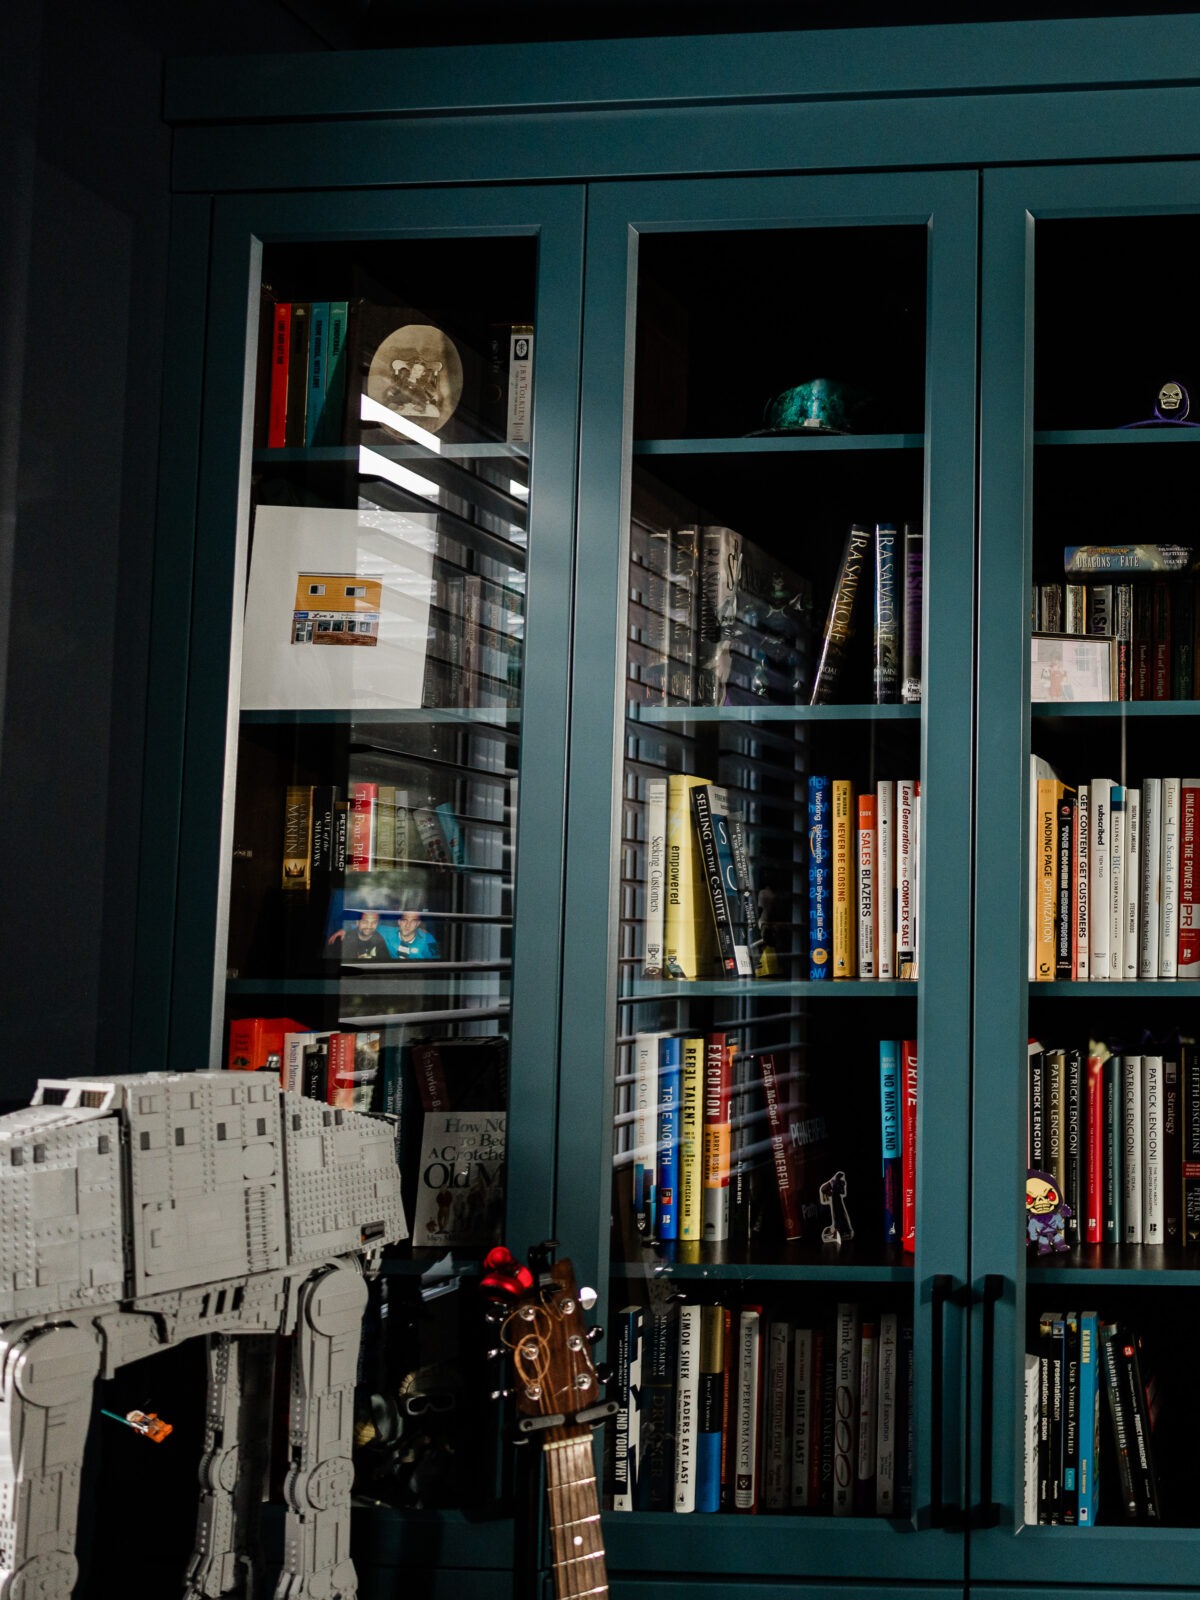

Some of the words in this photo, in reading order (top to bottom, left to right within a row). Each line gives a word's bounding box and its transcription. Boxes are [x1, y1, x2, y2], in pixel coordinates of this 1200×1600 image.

[848, 538, 868, 561] R.A.
[879, 537, 894, 560] R.A.
[1077, 557, 1110, 567] DRAGONS
[1120, 556, 1139, 566] FATE
[831, 564, 861, 642] SALVATORE
[879, 563, 893, 641] SALVATORE
[696, 793, 712, 840] SELLING
[1080, 794, 1088, 813] GET
[1184, 793, 1194, 841] UNLEASHING
[287, 804, 298, 853] MARTIN
[837, 822, 846, 850] NEVER
[1080, 814, 1088, 859] CONTENT
[649, 836, 663, 867] Seeking
[705, 843, 713, 855] TO
[708, 857, 716, 872] THE
[837, 853, 846, 863] BE
[861, 832, 871, 866] SALES
[1184, 843, 1193, 858] THE
[669, 846, 681, 905] empowered
[837, 866, 846, 902] CLOSING
[1079, 862, 1088, 880] GET
[1184, 860, 1193, 889] POWER
[650, 870, 662, 912] Customers
[711, 876, 726, 921] C-SUITE
[861, 869, 871, 917] BLAZERS
[1184, 891, 1193, 901] OF
[1044, 879, 1052, 943] OPTIMIZATION
[1079, 882, 1087, 938] CUSTOMERS
[1182, 904, 1193, 927] PR
[707, 1044, 723, 1117] EXECUTION
[884, 1074, 894, 1087] NO
[1033, 1069, 1041, 1108] PATRICK
[1050, 1064, 1058, 1104] PATRICK
[1126, 1064, 1134, 1104] PATRICK
[1149, 1068, 1157, 1108] PATRICK
[662, 1086, 673, 1119] TRUE
[885, 1091, 895, 1122] MAN'S
[445, 1119, 480, 1132] How
[885, 1125, 896, 1150] LAND
[1034, 1111, 1042, 1160] LENCIONI
[1050, 1109, 1059, 1158] LENCIONI
[1070, 1105, 1078, 1154] LENCIONI
[1127, 1107, 1135, 1156] LENCIONI
[1150, 1111, 1158, 1160] LENCIONI
[662, 1124, 673, 1165] NORTH
[424, 1163, 471, 1189] Old
[681, 1312, 691, 1346] SIMON
[744, 1326, 753, 1368] PEOPLE
[1082, 1330, 1091, 1364] KANBAN
[681, 1351, 690, 1379] SINEK
[616, 1408, 628, 1430] FIND
[682, 1390, 691, 1434] LEADERS
[741, 1384, 751, 1468] PERFORMANCE
[616, 1432, 627, 1458] YOUR
[681, 1438, 690, 1456] EAT
[615, 1460, 627, 1483] WHY
[680, 1460, 689, 1485] LAST
